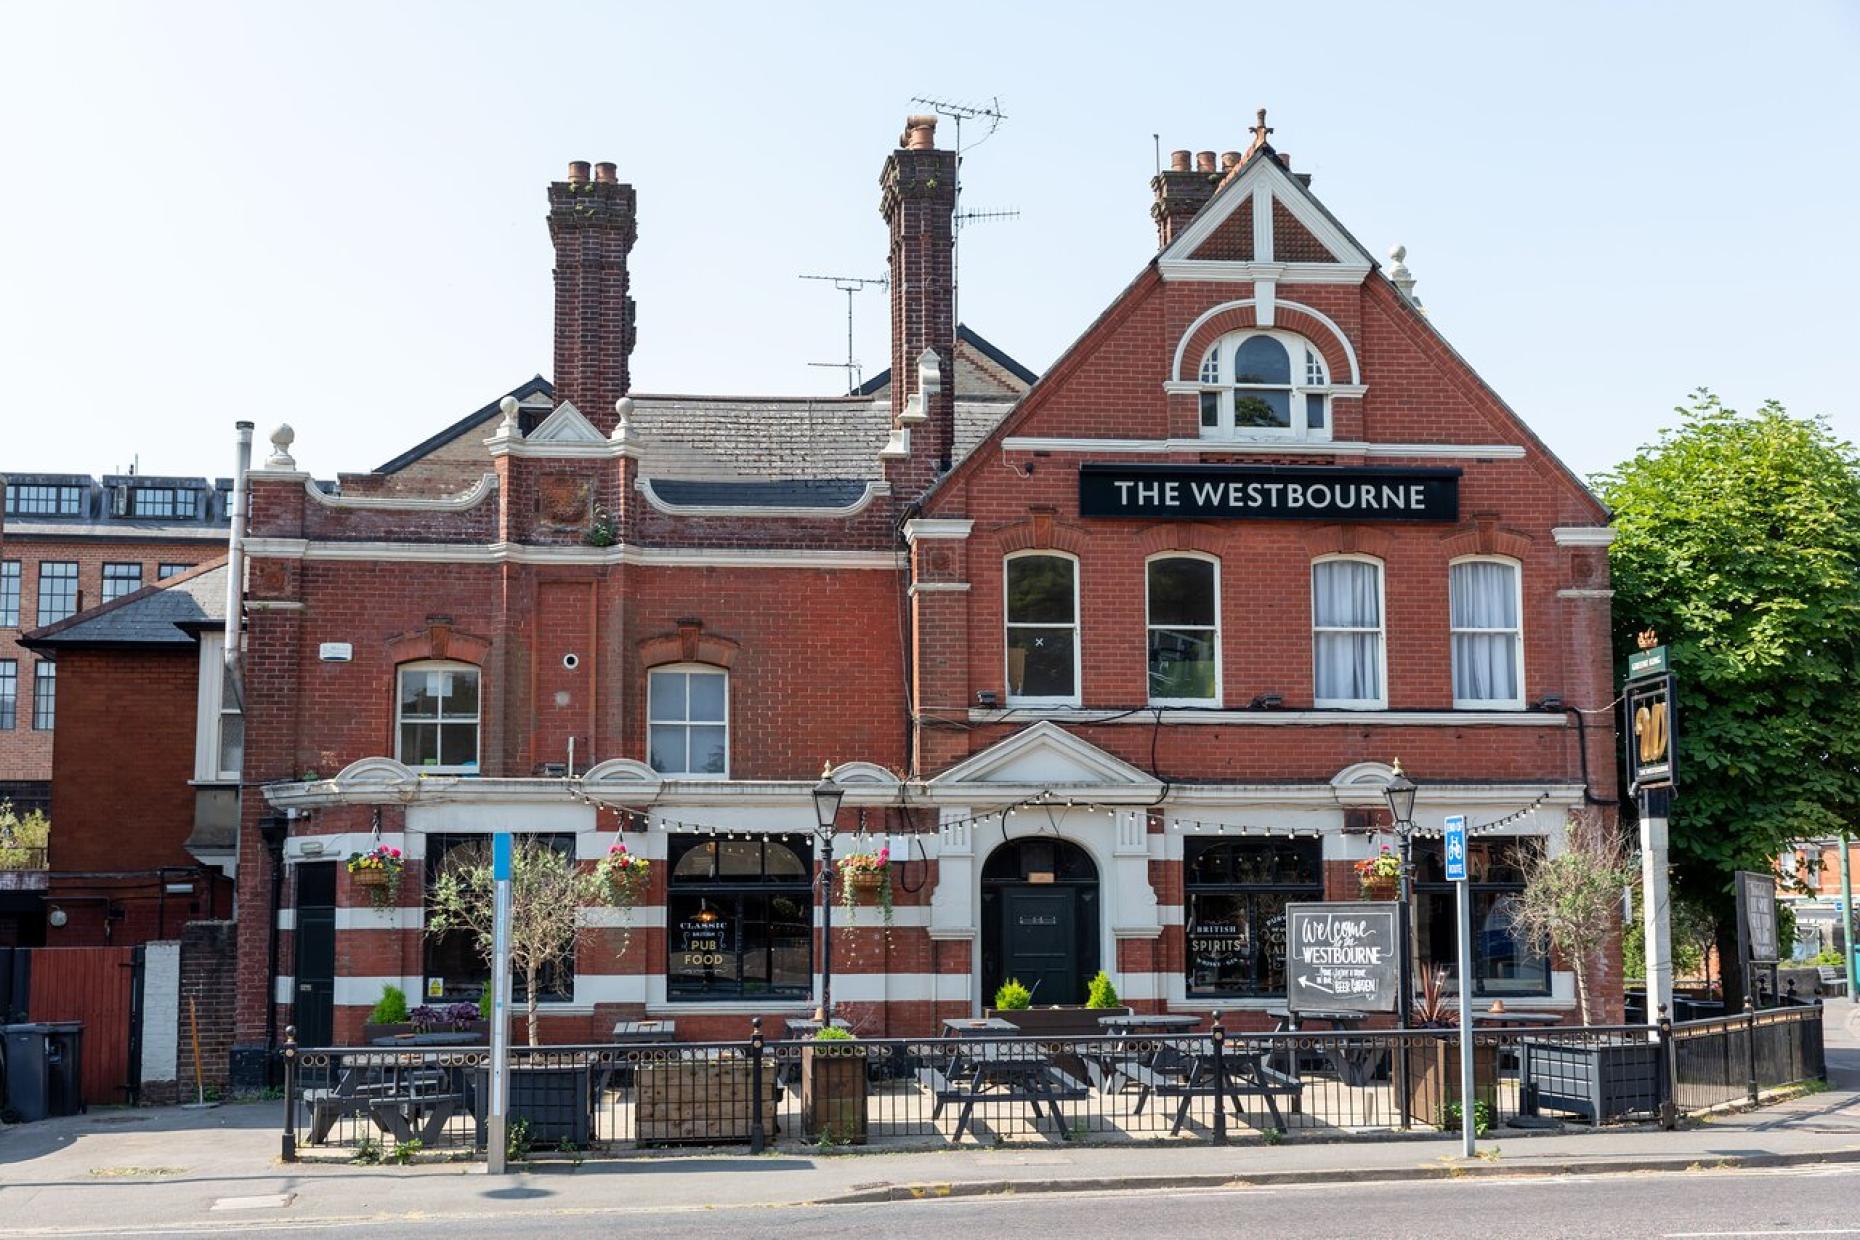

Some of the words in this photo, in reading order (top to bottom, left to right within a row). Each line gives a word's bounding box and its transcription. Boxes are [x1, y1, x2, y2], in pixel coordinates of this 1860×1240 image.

[1113, 481, 1180, 507] THE
[1190, 482, 1426, 510] WESTBOURNE
[679, 922, 728, 930] CLASSIC
[1196, 925, 1237, 934] BRITISH
[1301, 914, 1377, 943] Welcome
[691, 940, 717, 950] PUB
[1192, 939, 1241, 952] SPIRITS
[684, 954, 723, 965] FOOD
[1302, 946, 1382, 965] WESTBOURNE
